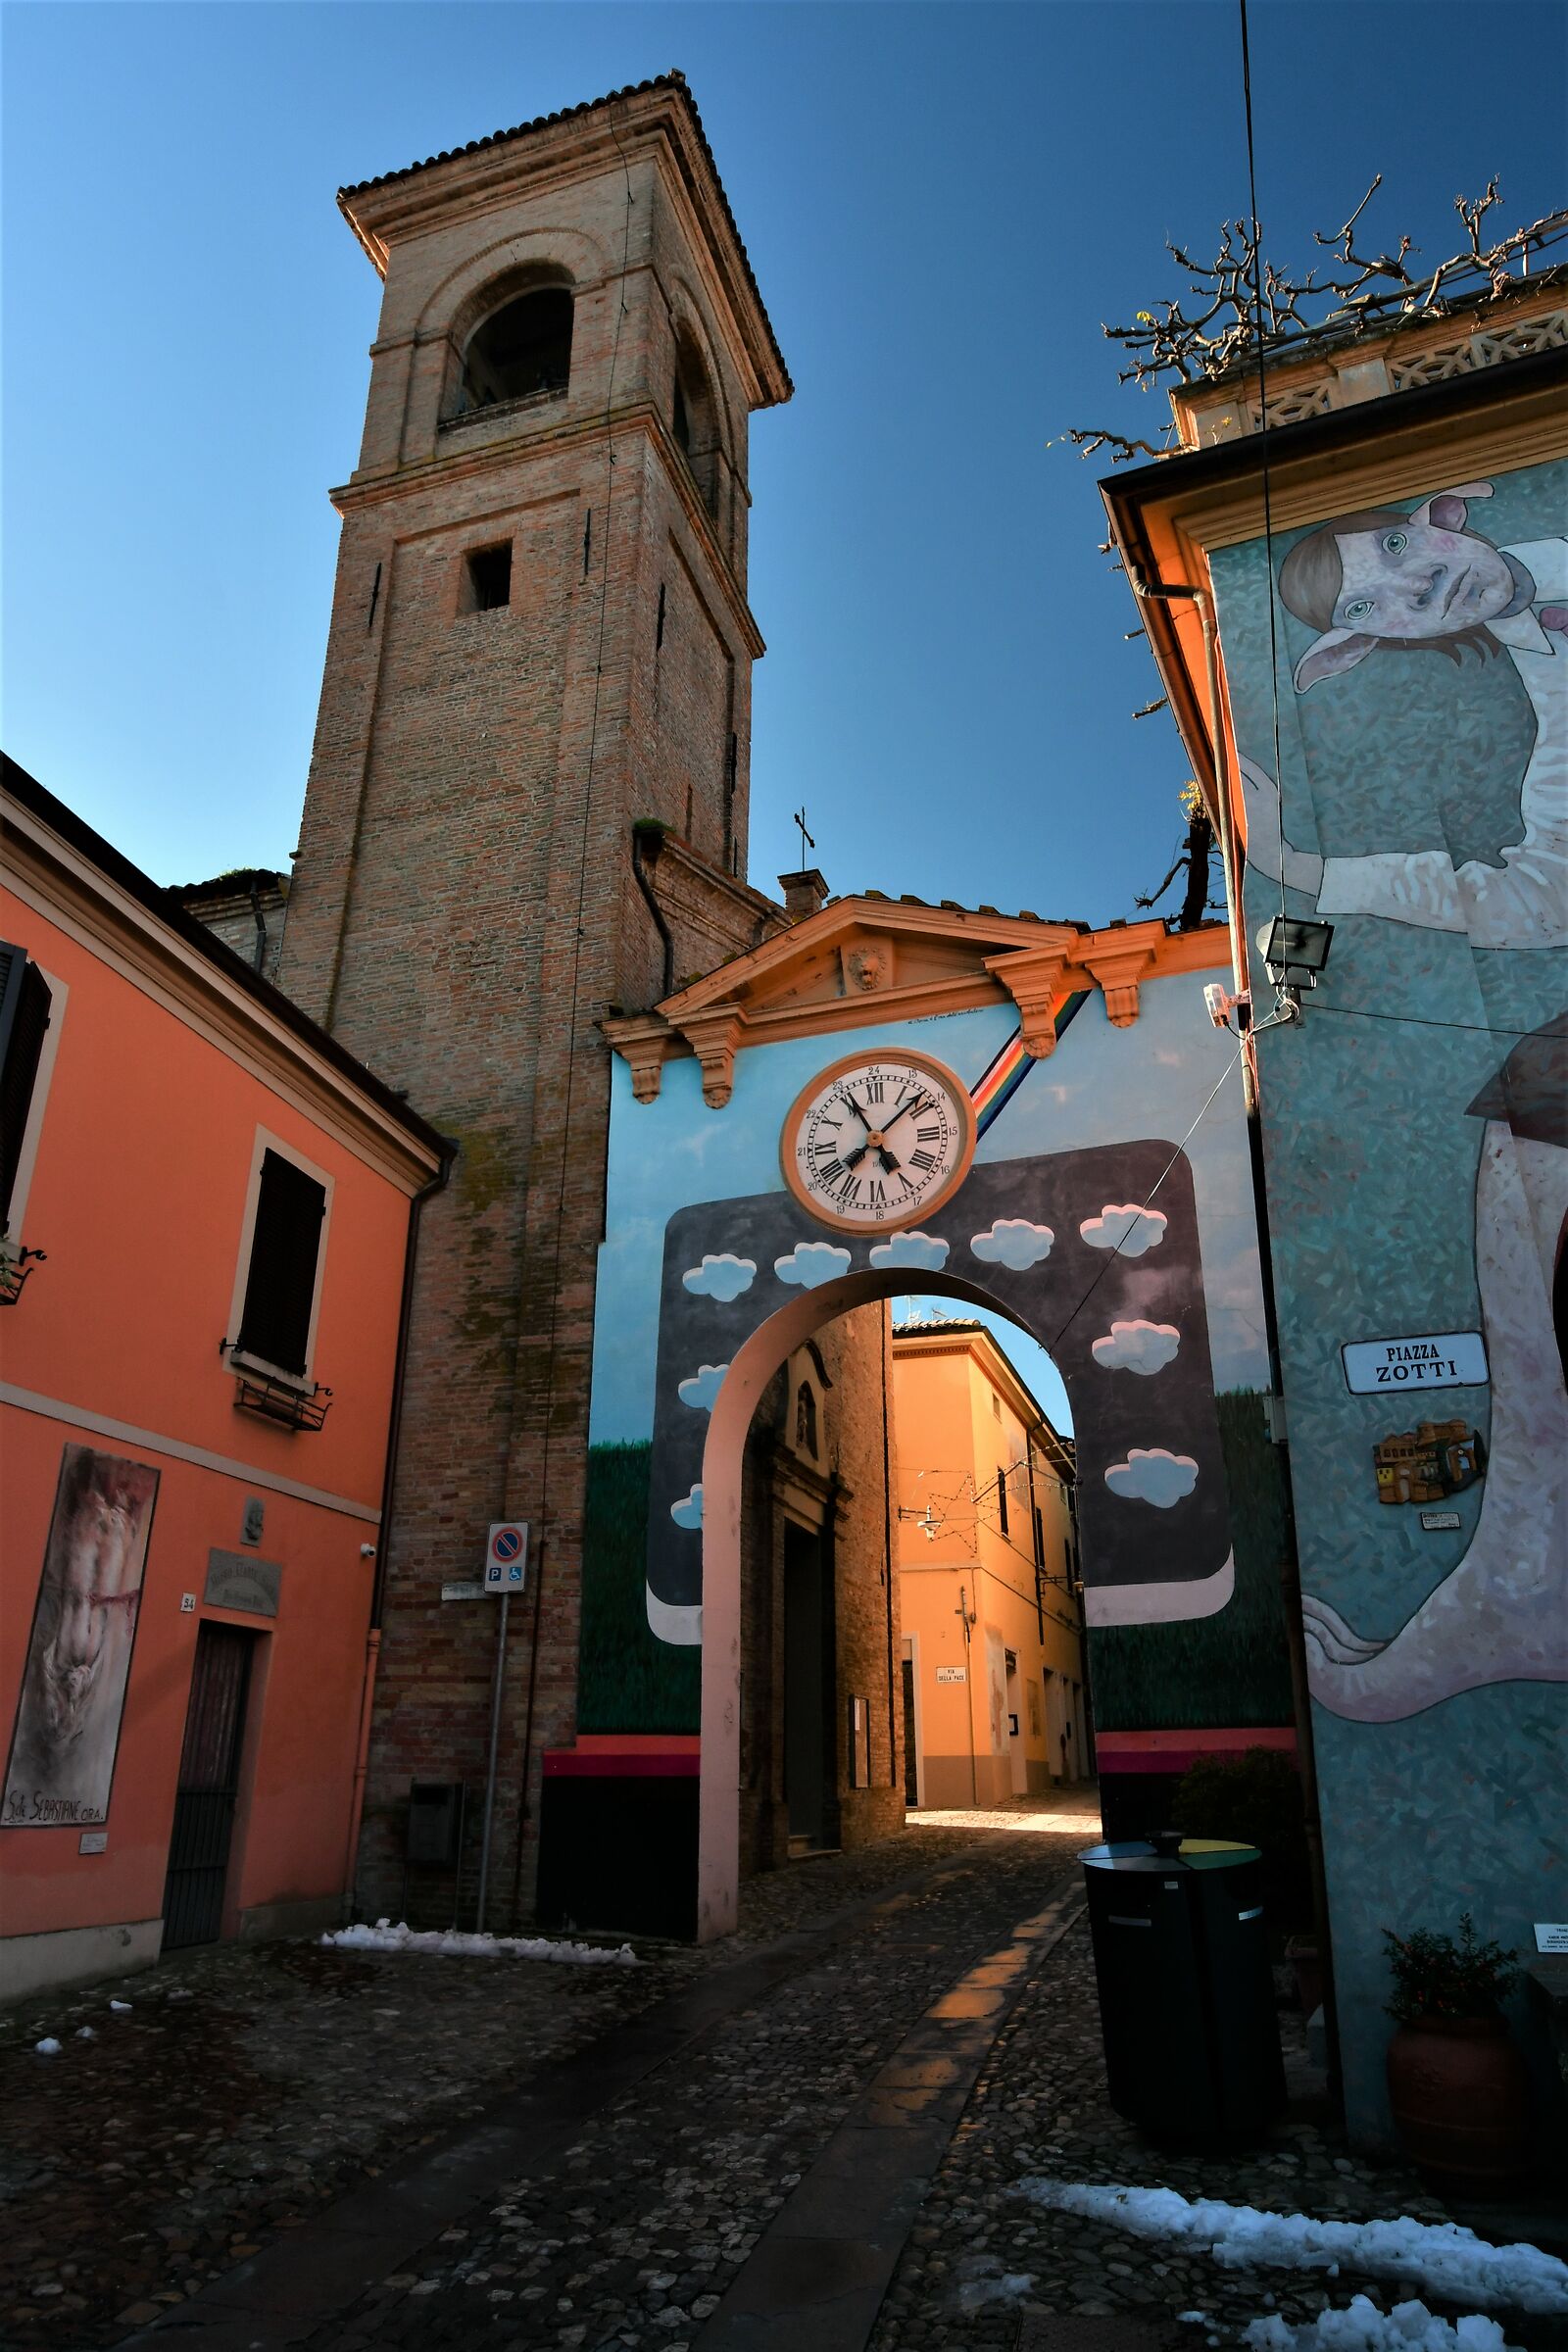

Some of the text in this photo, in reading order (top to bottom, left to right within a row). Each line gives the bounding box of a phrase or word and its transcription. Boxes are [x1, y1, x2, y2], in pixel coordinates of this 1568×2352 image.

[868, 1066, 880, 1075] 24
[908, 1069, 917, 1078] 13
[832, 1081, 843, 1090] 23
[866, 1082, 884, 1105] XII
[937, 1092, 946, 1102] 14
[949, 1127, 957, 1136] 15
[797, 1147, 807, 1155] 21
[941, 1166, 951, 1175] 16
[808, 1182, 817, 1191] 20
[870, 1180, 886, 1202] VI
[912, 1197, 922, 1206] 17
[836, 1205, 845, 1214] 19
[875, 1211, 885, 1220] 18
[1386, 1344, 1440, 1362] PIAZZA
[1375, 1360, 1458, 1383] ZOTTI
[491, 1569, 500, 1580] P
